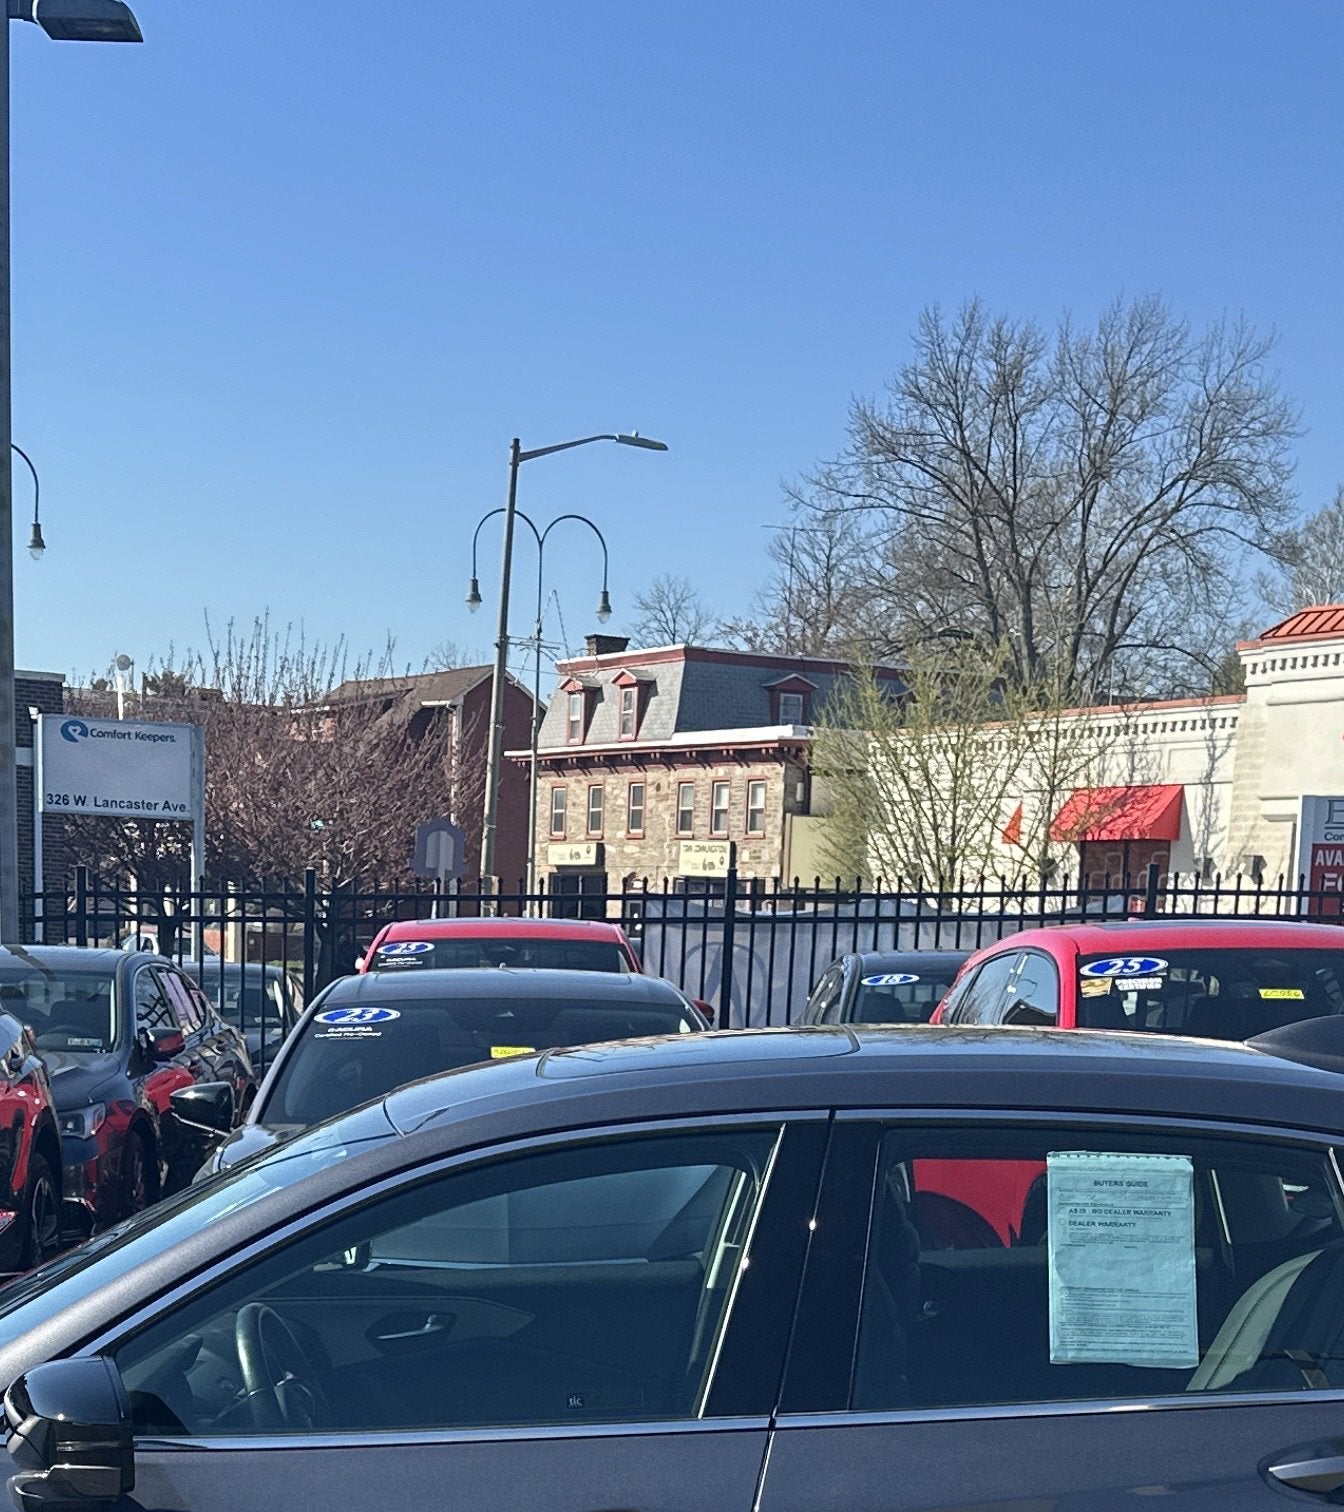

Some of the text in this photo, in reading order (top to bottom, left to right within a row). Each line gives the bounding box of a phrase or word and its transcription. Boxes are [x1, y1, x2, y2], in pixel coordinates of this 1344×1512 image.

[89, 728, 175, 743] Comfort Keepers
[46, 793, 70, 806] 326
[94, 796, 159, 811] Lancaster
[1104, 958, 1142, 974] 25
